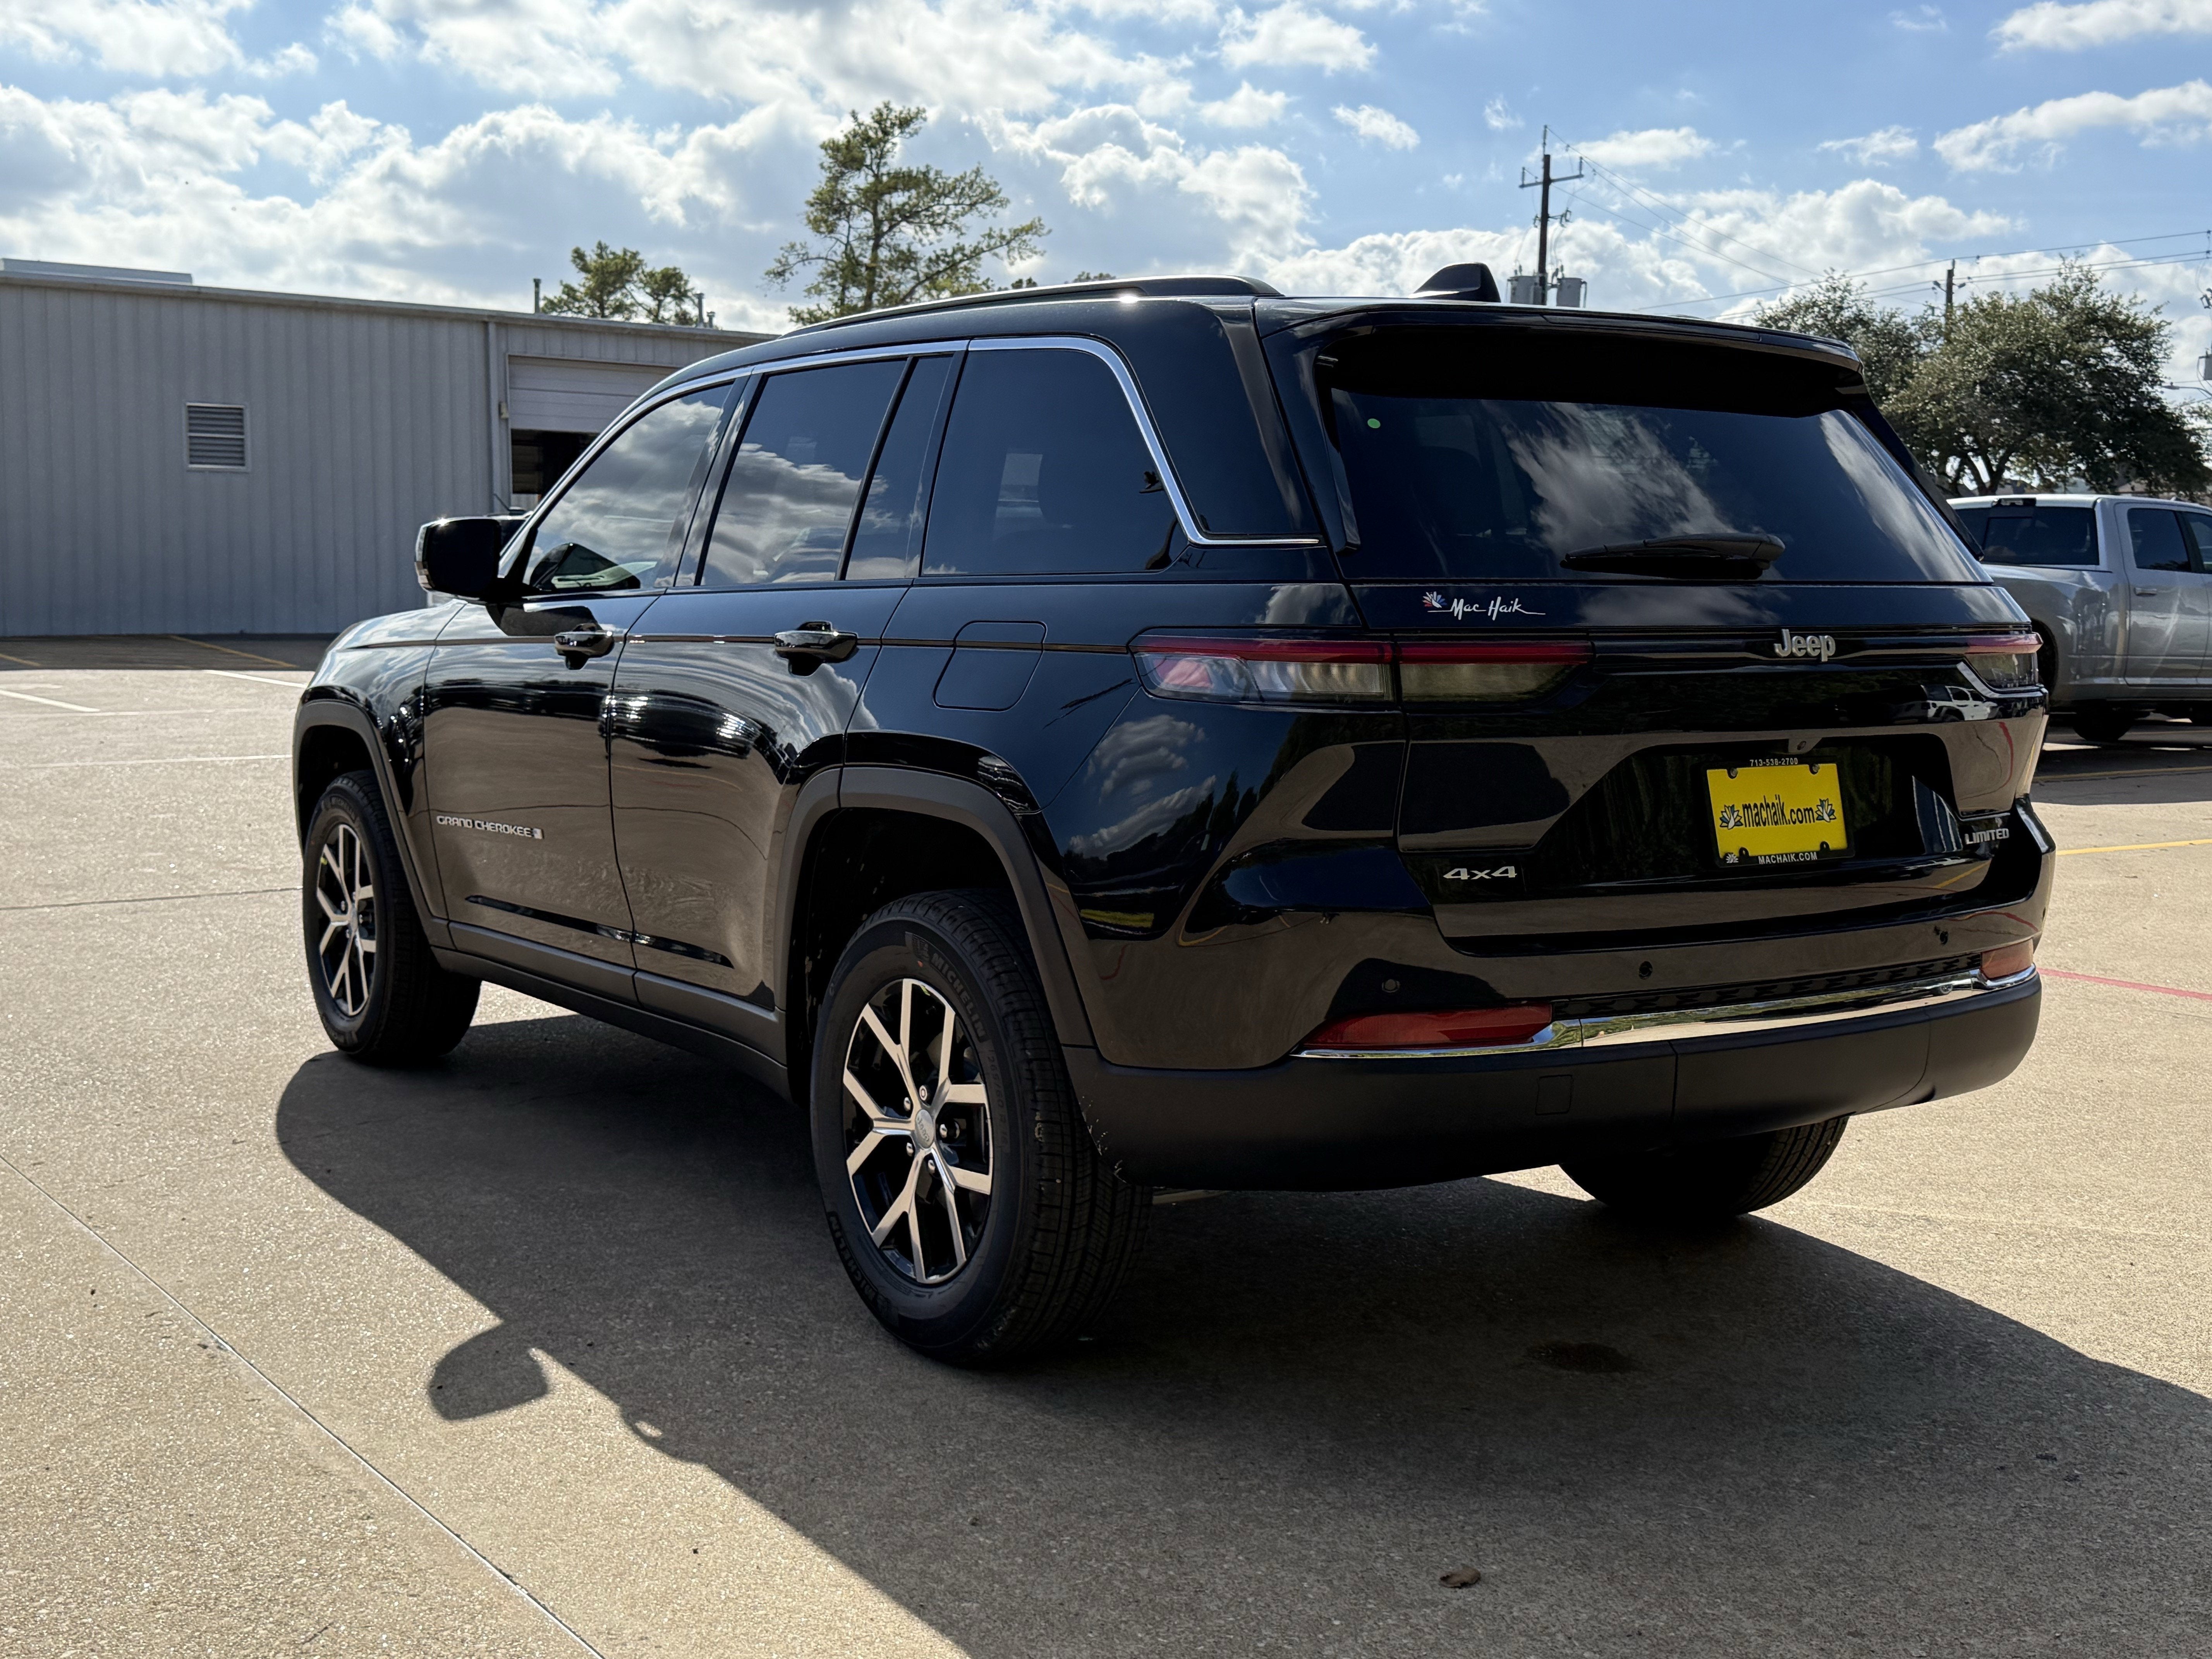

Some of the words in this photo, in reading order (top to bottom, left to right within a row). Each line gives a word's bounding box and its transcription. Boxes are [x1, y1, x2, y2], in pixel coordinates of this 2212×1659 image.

[1441, 598, 1486, 620] Mac
[1487, 596, 1534, 620] Haik
[1774, 629, 1836, 662] Jeep
[1749, 757, 1798, 767] 713-538-2700
[1742, 794, 1815, 828] machaik.com
[436, 816, 473, 828] GRAND
[474, 820, 532, 837] CHEROKEE
[1964, 828, 2010, 845] LIMITED
[1758, 852, 1817, 864] MACHAIK.COM
[1443, 866, 1517, 879] 4x4
[931, 953, 988, 1038] MICHELIN
[829, 1215, 876, 1302] MICHELIN
